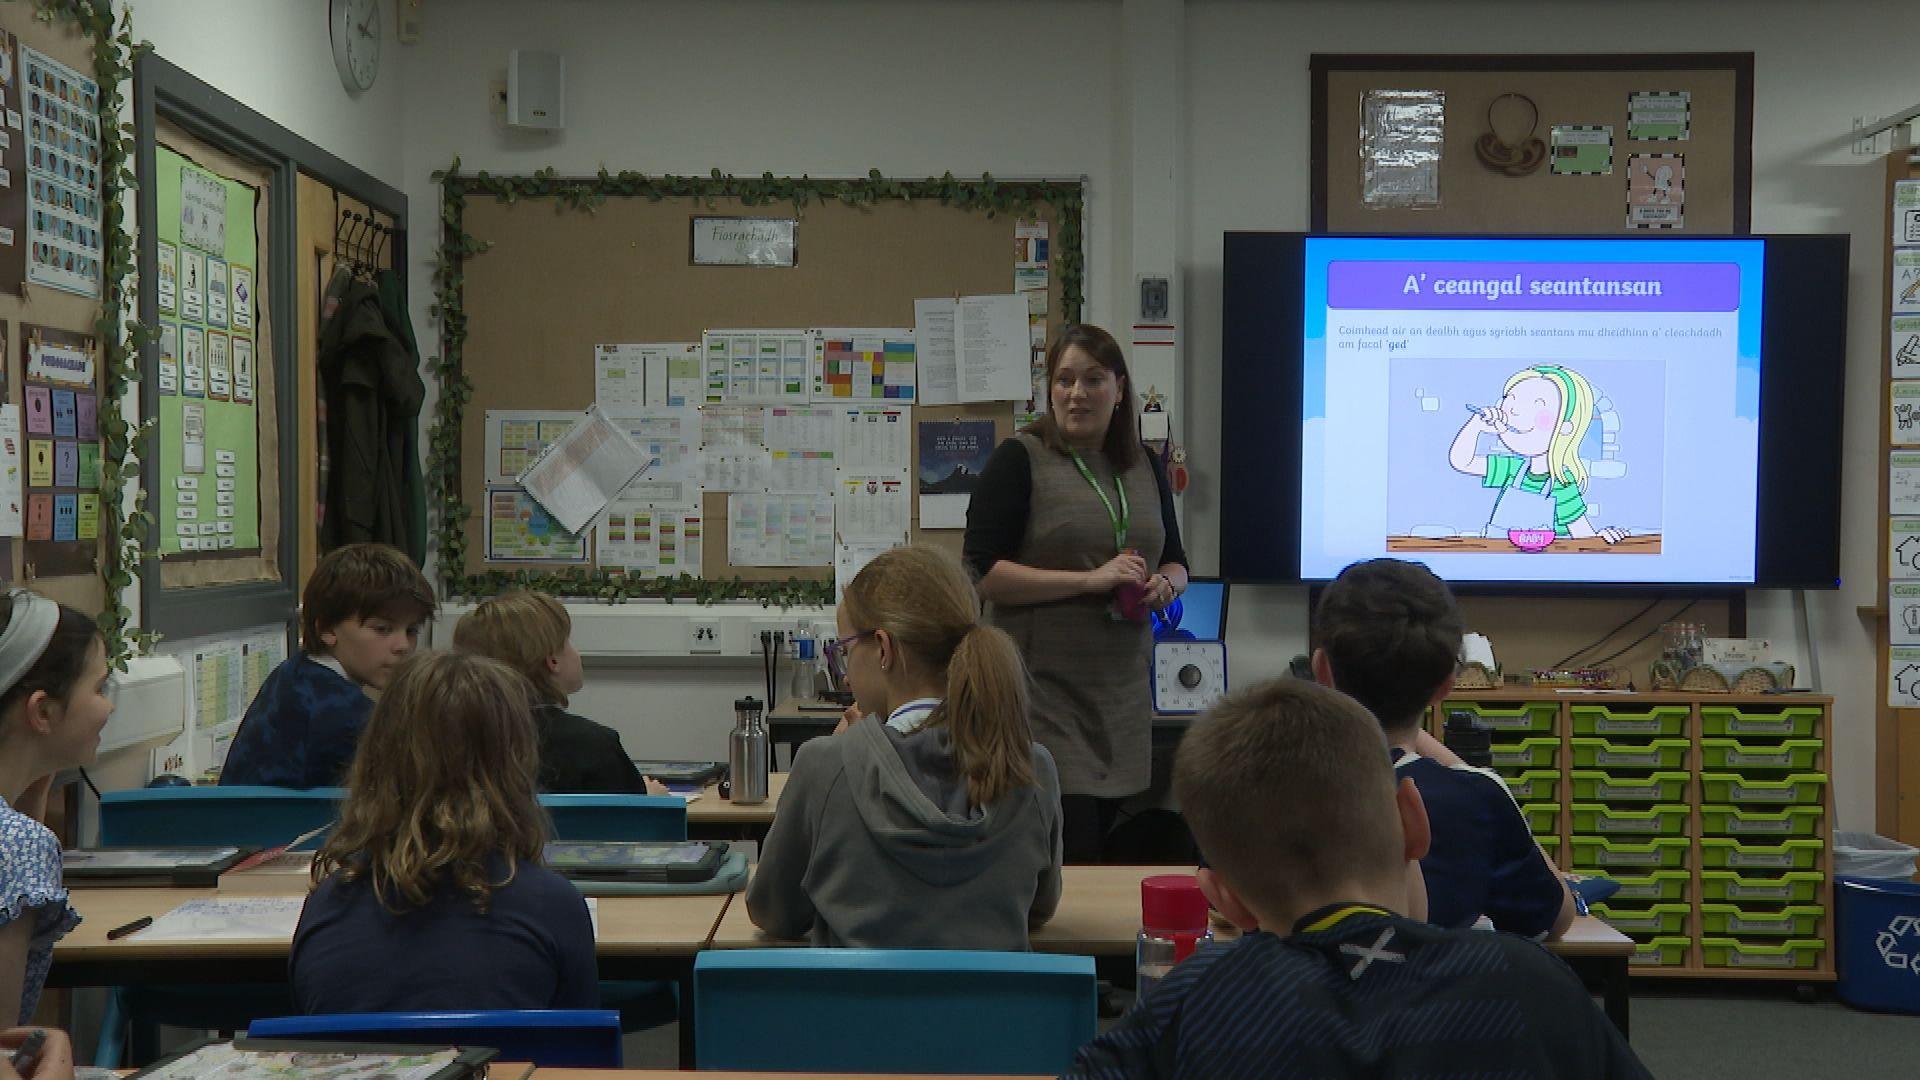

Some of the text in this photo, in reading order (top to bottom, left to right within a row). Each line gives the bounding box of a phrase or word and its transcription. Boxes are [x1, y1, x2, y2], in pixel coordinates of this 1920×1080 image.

[1403, 273, 1663, 301] A' ceangal seantansan
[1338, 325, 1389, 337] Coimhead
[1391, 326, 1406, 336] air
[1409, 328, 1422, 336] an
[1425, 326, 1459, 337] dealbh
[1462, 328, 1487, 340] agus
[1530, 328, 1575, 337] seantans
[1578, 329, 1594, 337] mu
[1597, 327, 1649, 337] dheidhinn
[1664, 327, 1722, 337] cleachdadh
[1338, 341, 1355, 349] am
[1358, 339, 1383, 351] facal
